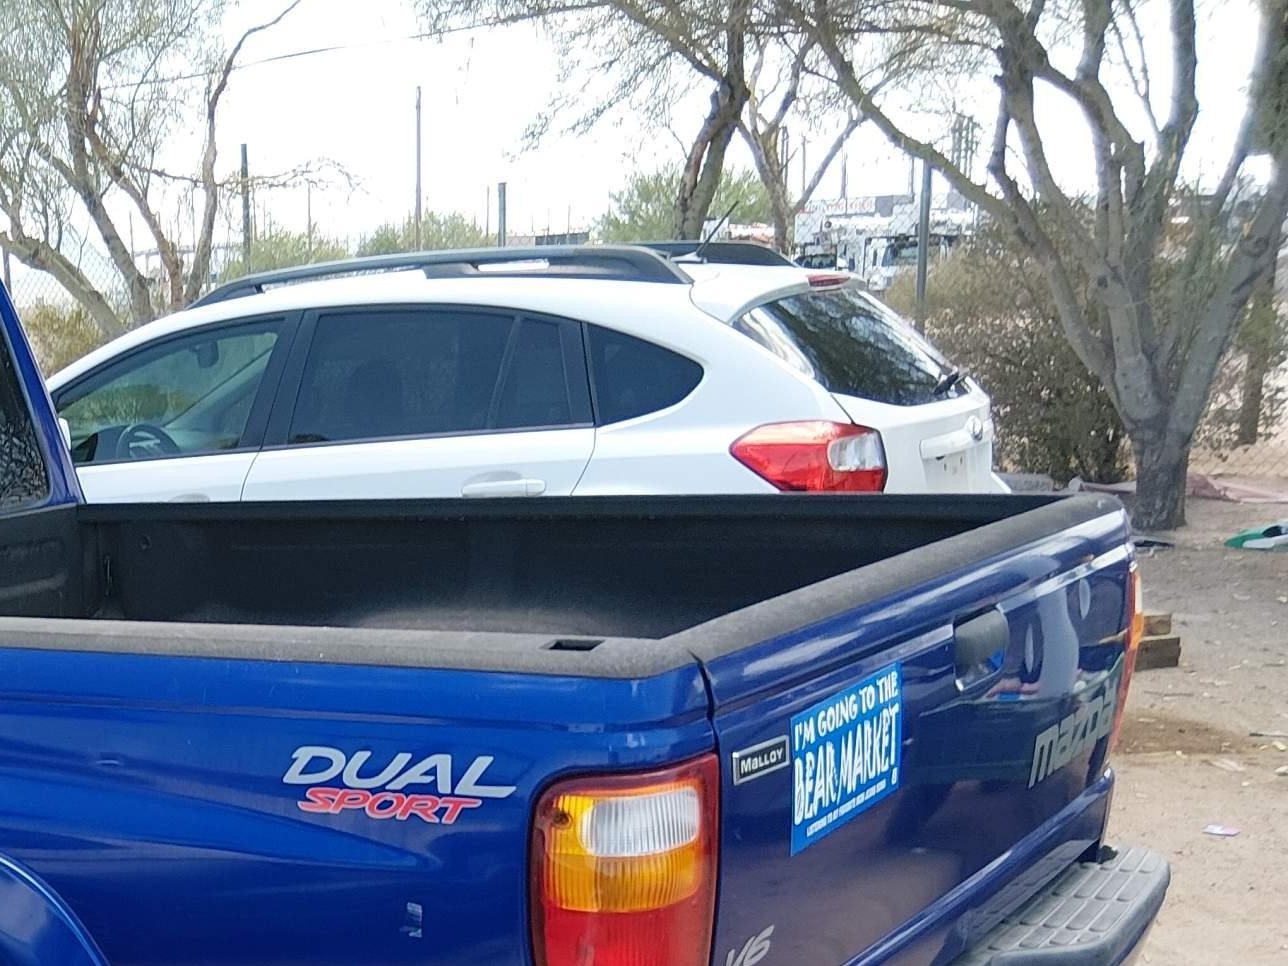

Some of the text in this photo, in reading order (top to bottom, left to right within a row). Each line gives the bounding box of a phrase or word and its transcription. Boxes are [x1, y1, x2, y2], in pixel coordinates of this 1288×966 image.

[795, 671, 898, 751] I'M GOING TO THE
[282, 746, 517, 798] DUAL
[837, 703, 900, 806] MARKET
[297, 787, 482, 824] SPORT
